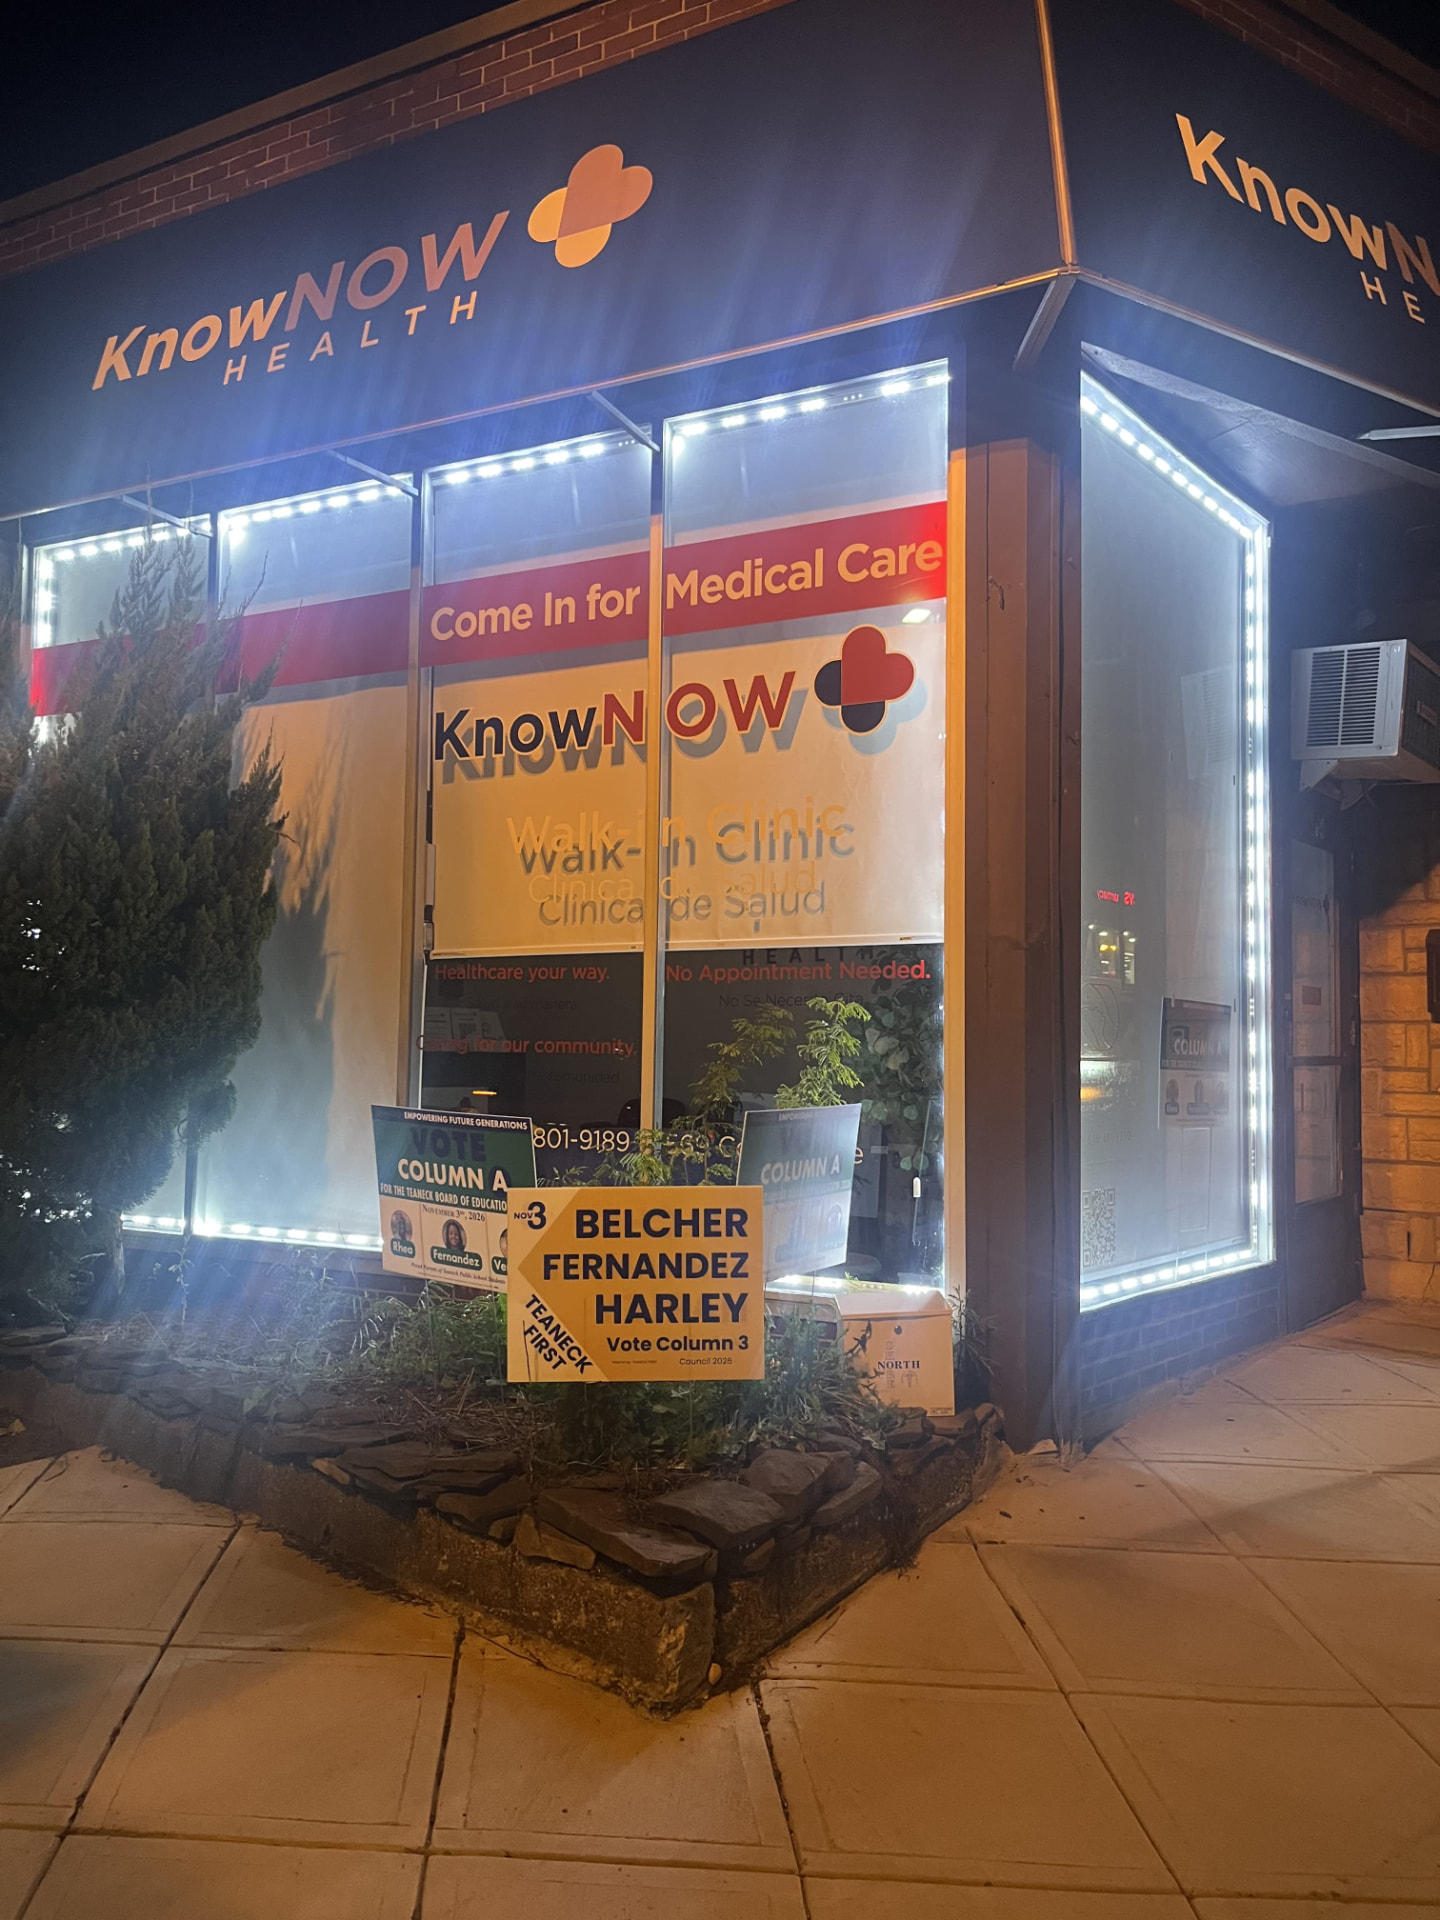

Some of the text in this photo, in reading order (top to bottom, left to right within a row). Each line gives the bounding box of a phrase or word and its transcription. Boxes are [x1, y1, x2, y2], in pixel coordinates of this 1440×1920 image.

[92, 210, 510, 391] KnowNOW
[223, 290, 479, 386] HEALTH
[430, 539, 943, 641] Come In for Medical Care
[434, 670, 797, 760] KnowNOW
[706, 796, 845, 844] Clinic
[434, 963, 523, 981] Healthcare
[528, 966, 567, 983] your
[666, 960, 931, 985] No Appointment Needed.
[474, 1036, 499, 1052] for
[502, 1040, 530, 1053] our
[1174, 1038, 1214, 1057] COLUMN
[404, 1111, 528, 1131] EMPOWERING FUTURE GENERATIONS
[410, 1127, 487, 1163] VOTE
[398, 1158, 508, 1193] COLUMN A
[760, 1158, 828, 1185] COLUMN
[829, 1153, 841, 1175] A
[380, 1182, 508, 1212] FOR THE TEANECK BOARD OF EDUCATIO
[514, 1201, 547, 1230] NOV 3
[575, 1207, 749, 1239] BELCHER
[392, 1241, 507, 1271] Rhea Fernandez Ve
[543, 1252, 749, 1281] FERNANDEZ
[595, 1292, 749, 1325] HARLEY
[524, 1324, 567, 1371] FIRST
[525, 1293, 594, 1375] TEANECK
[606, 1335, 750, 1352] Vote Column 3
[679, 1357, 711, 1366] Council
[877, 1360, 921, 1369] NORTH
